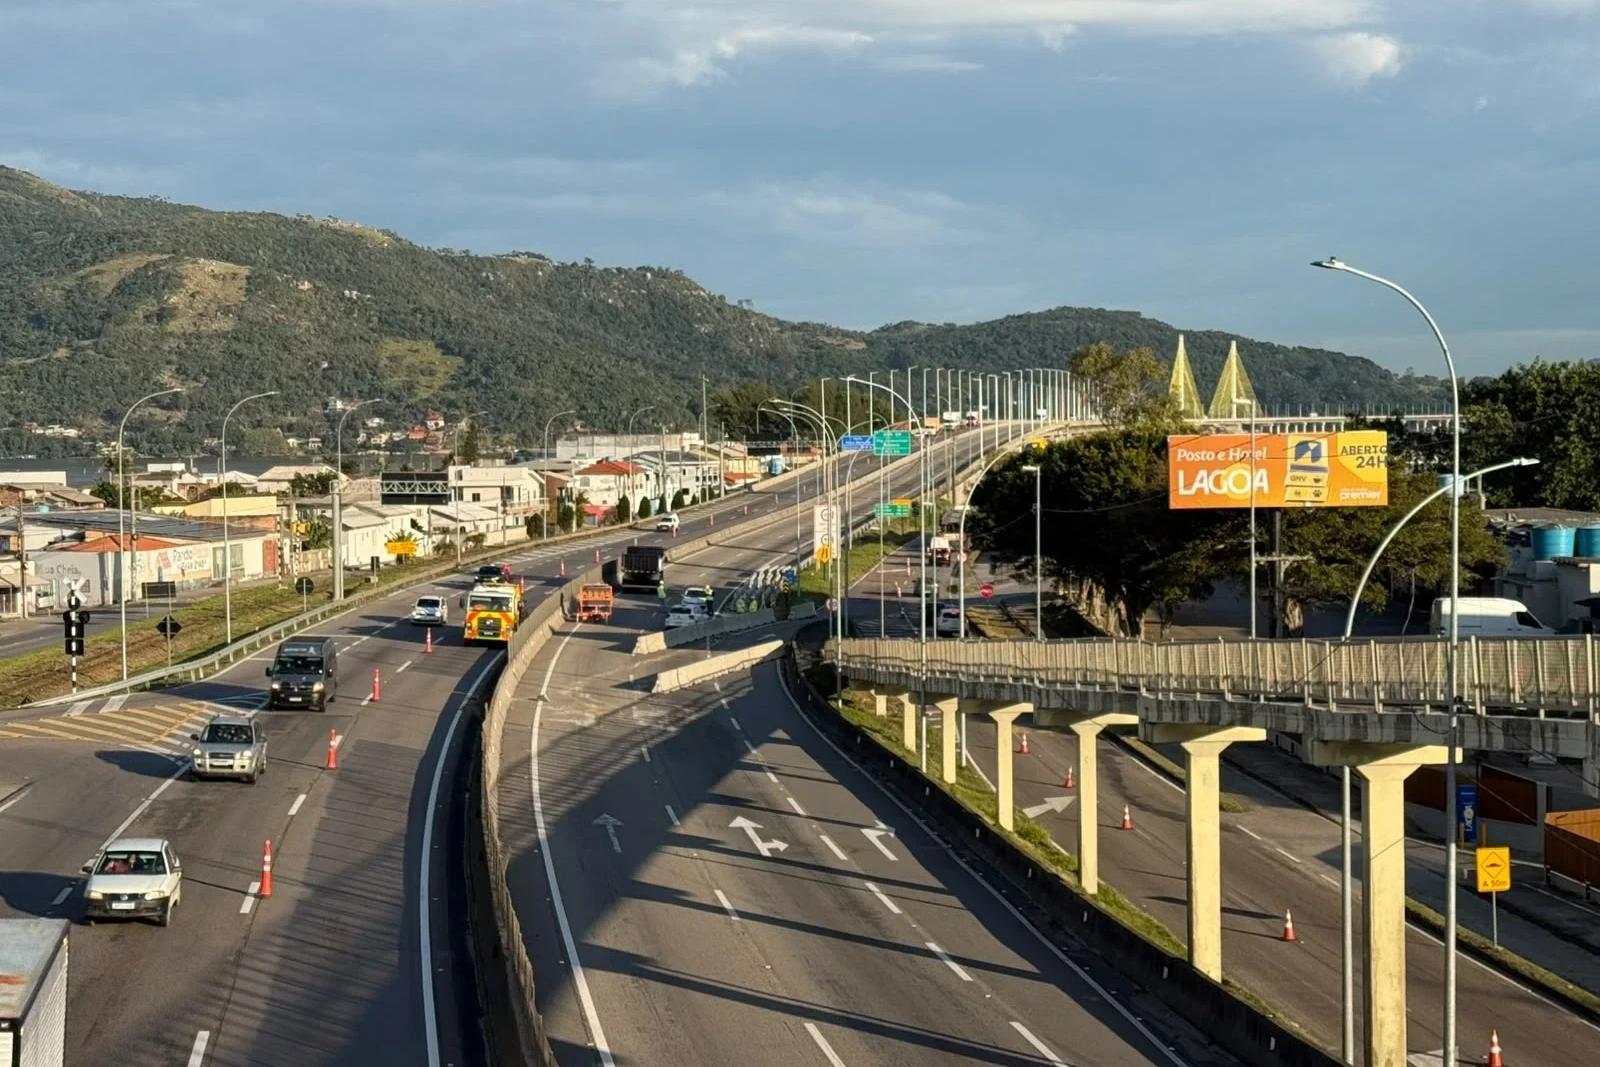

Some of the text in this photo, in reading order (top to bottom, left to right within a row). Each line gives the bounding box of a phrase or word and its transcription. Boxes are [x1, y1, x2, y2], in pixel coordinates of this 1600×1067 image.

[1177, 448, 1215, 461] Posto
[1217, 451, 1226, 461] e
[1341, 445, 1387, 456] ABERTO
[1355, 456, 1387, 469] 24H
[1178, 468, 1269, 496] LAGOA
